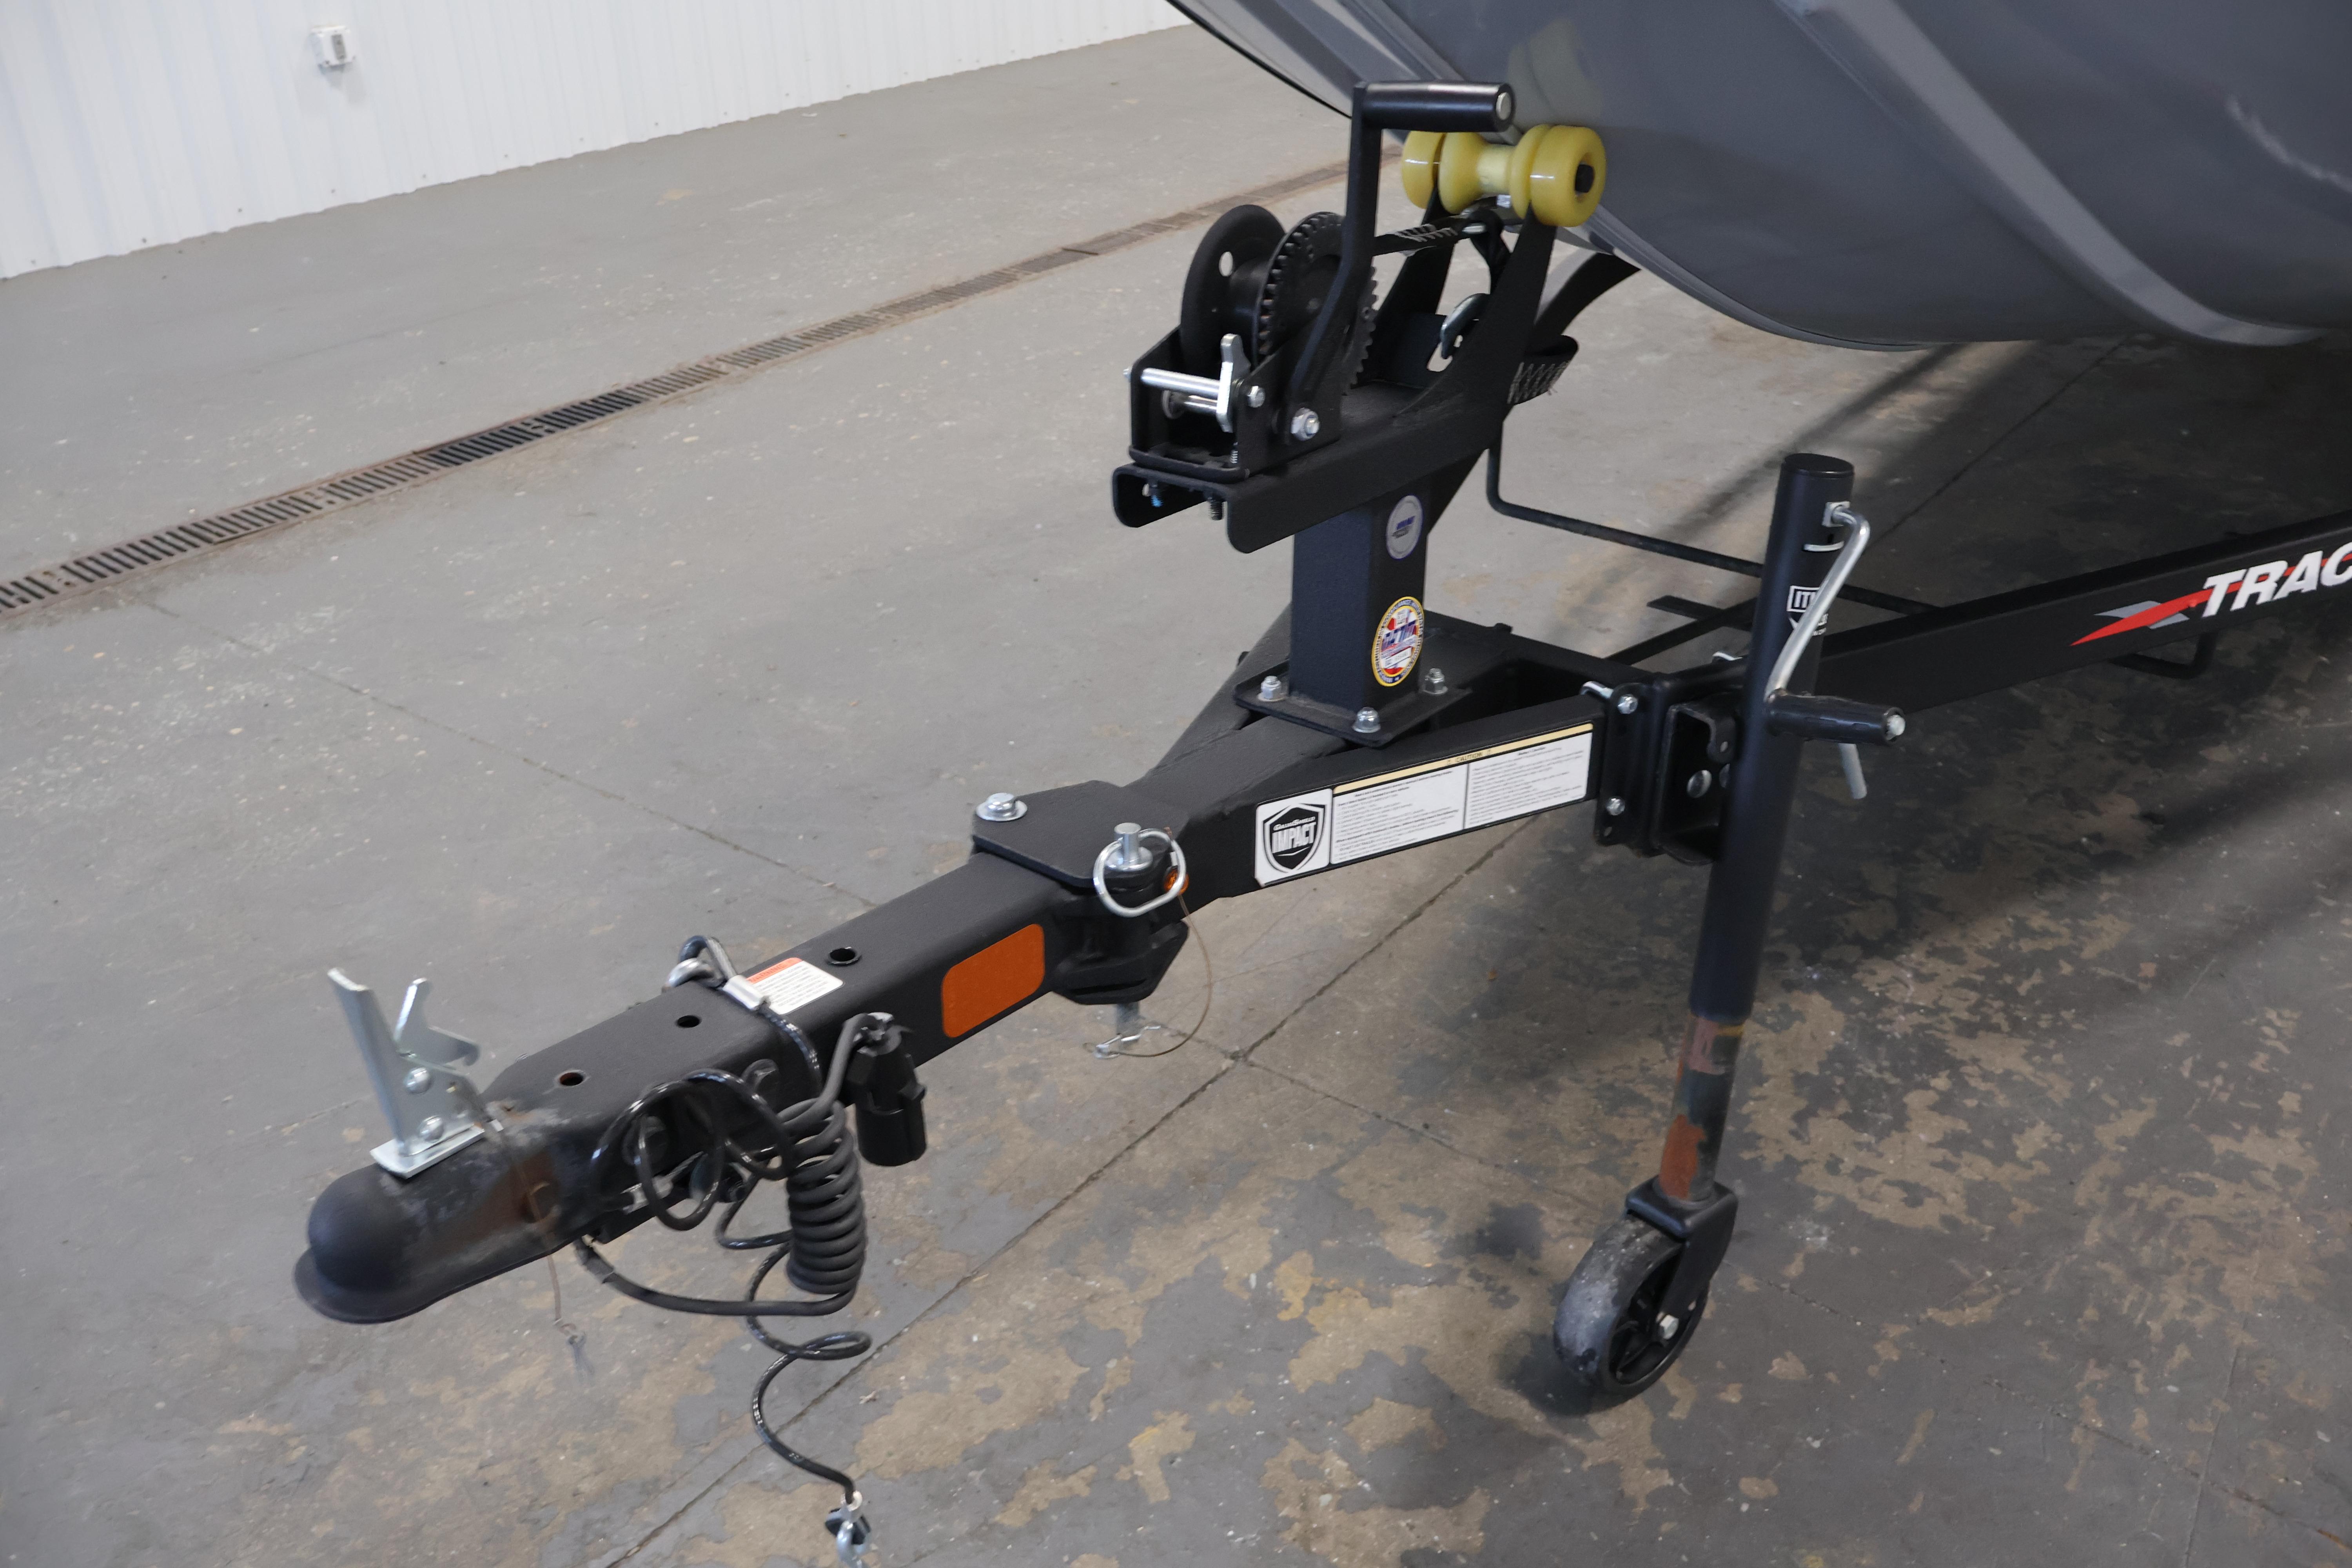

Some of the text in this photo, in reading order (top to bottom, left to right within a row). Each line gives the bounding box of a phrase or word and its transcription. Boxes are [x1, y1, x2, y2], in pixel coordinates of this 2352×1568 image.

[2201, 541, 2352, 618] TRAC
[1456, 751, 1483, 762] CAUTION
[1272, 822, 1316, 854] IMPACT
